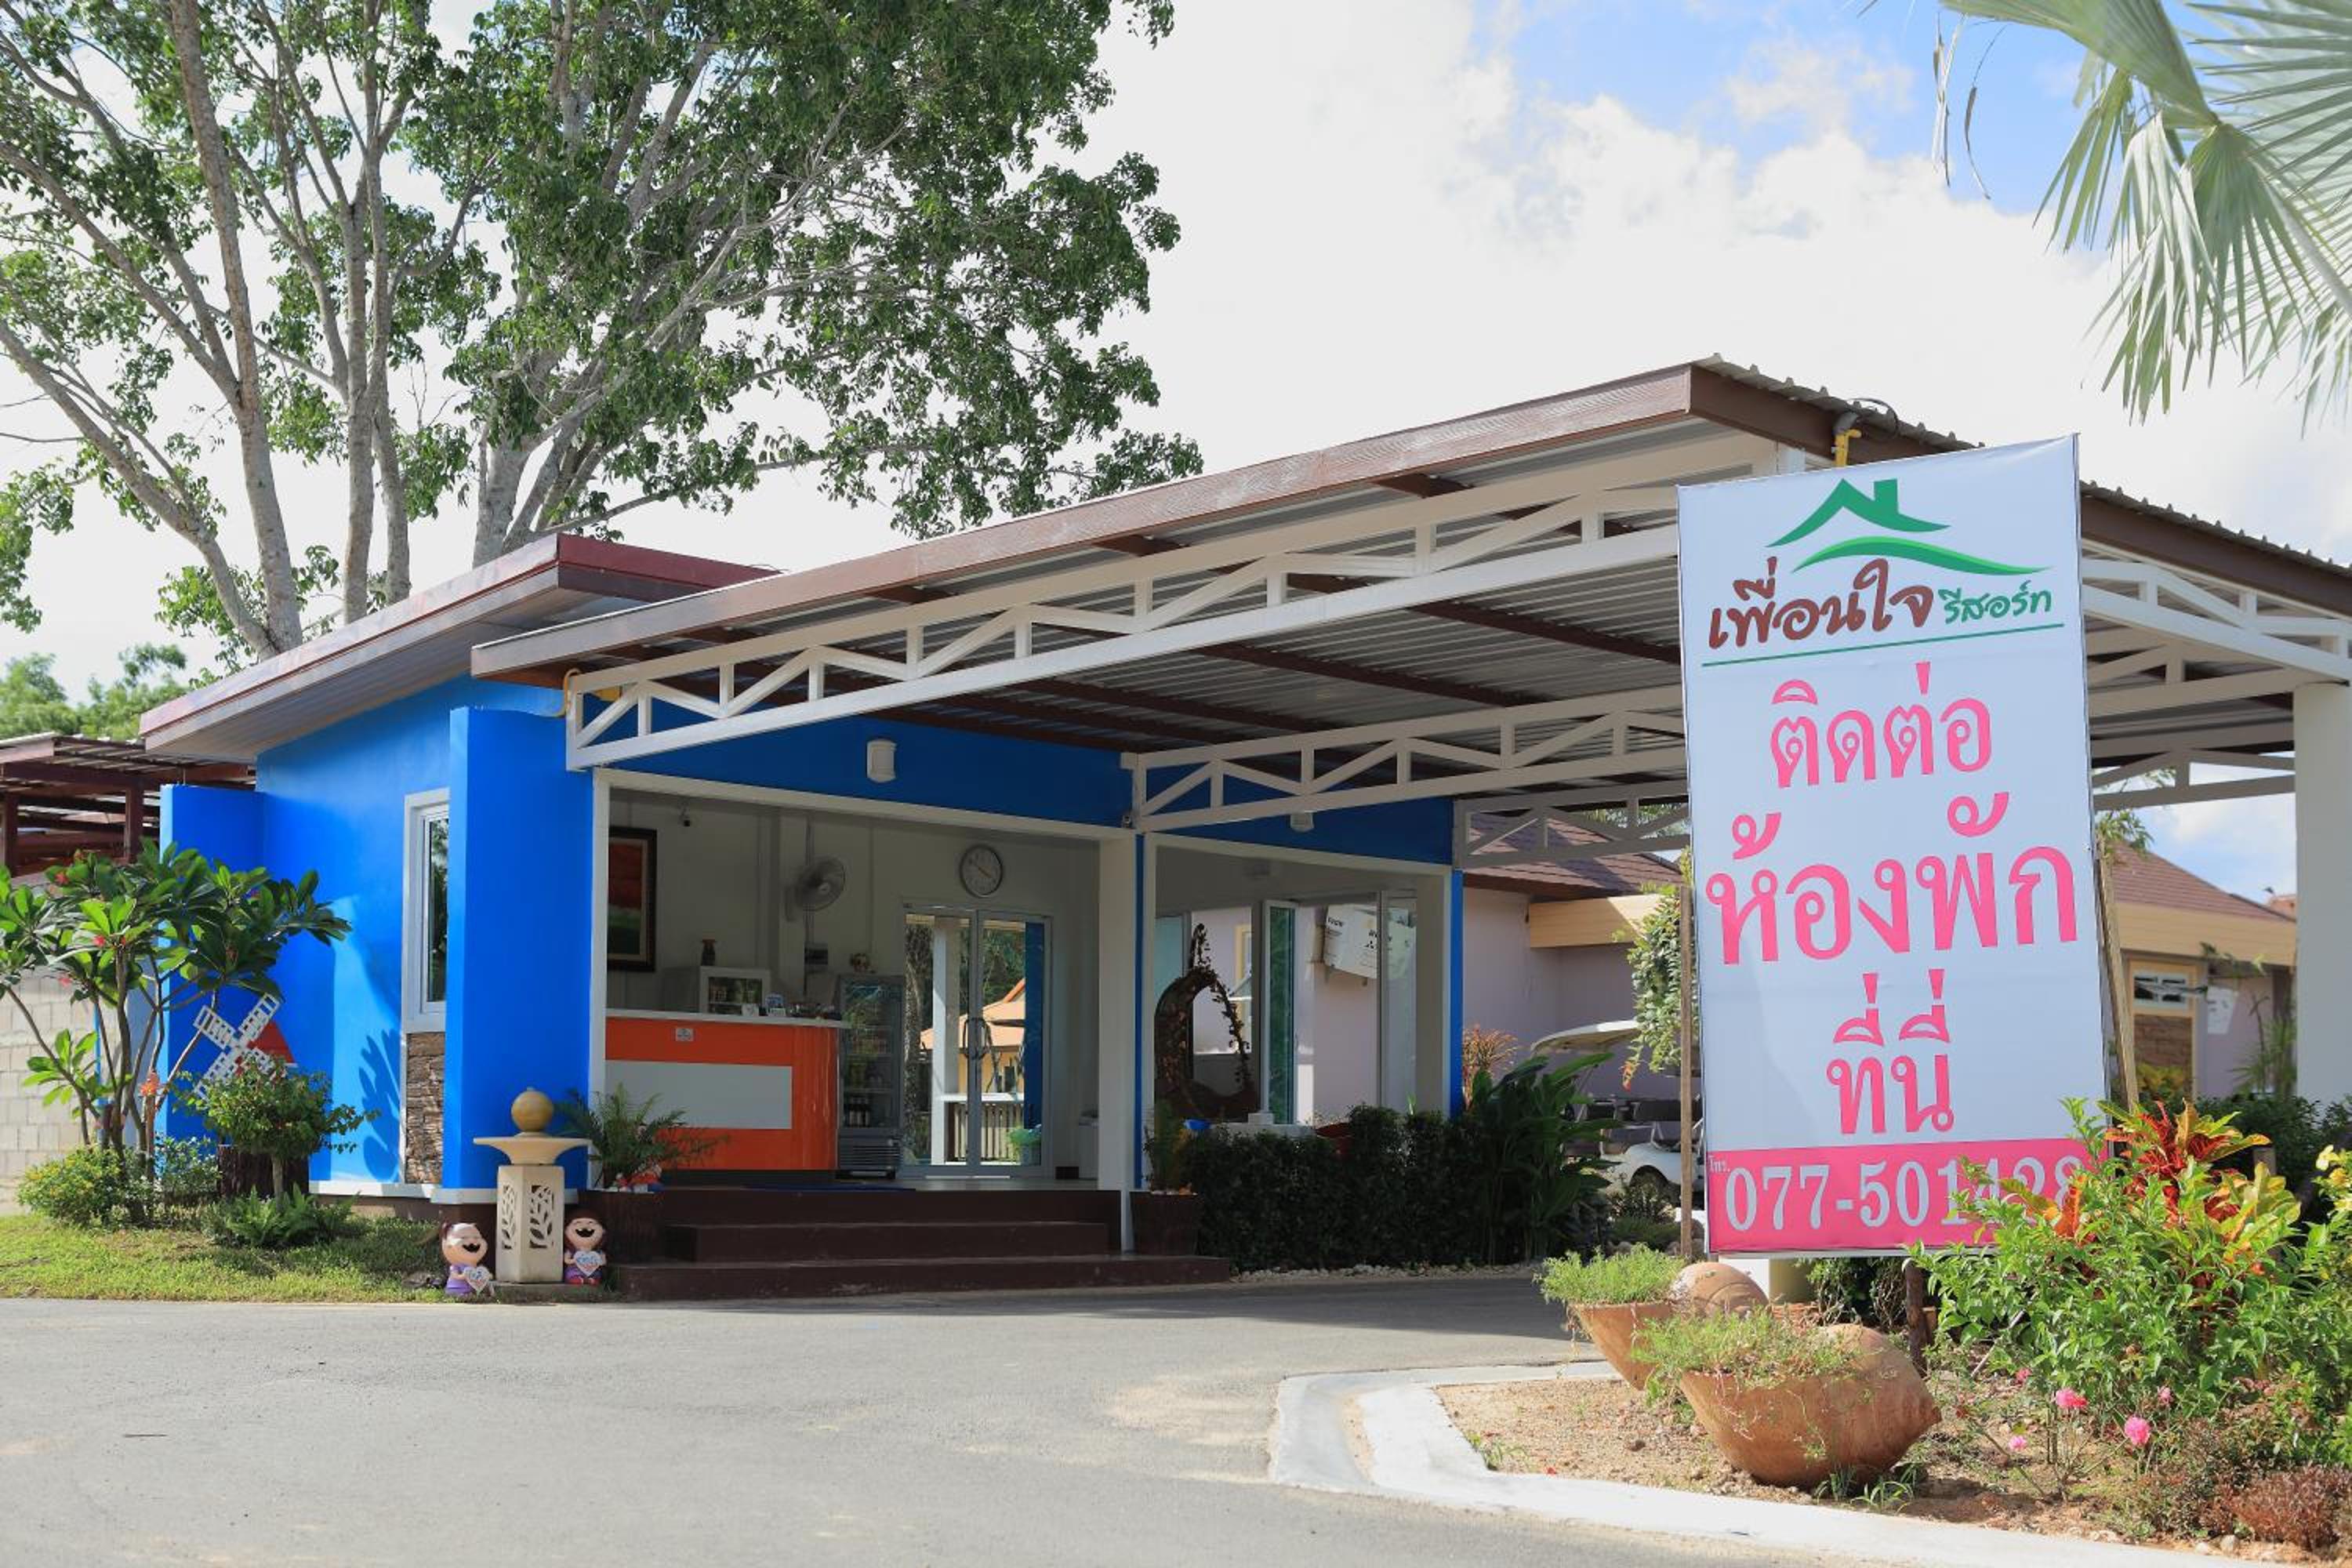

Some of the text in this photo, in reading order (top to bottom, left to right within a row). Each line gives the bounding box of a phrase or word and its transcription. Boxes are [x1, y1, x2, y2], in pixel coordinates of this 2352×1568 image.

[1708, 557, 2052, 650] เพื่อนใจ รีสอร์ท
[1770, 661, 1992, 789] ติดต่อ
[1705, 792, 2078, 966] ห้องพัก
[1826, 968, 1955, 1135] ที่นี่
